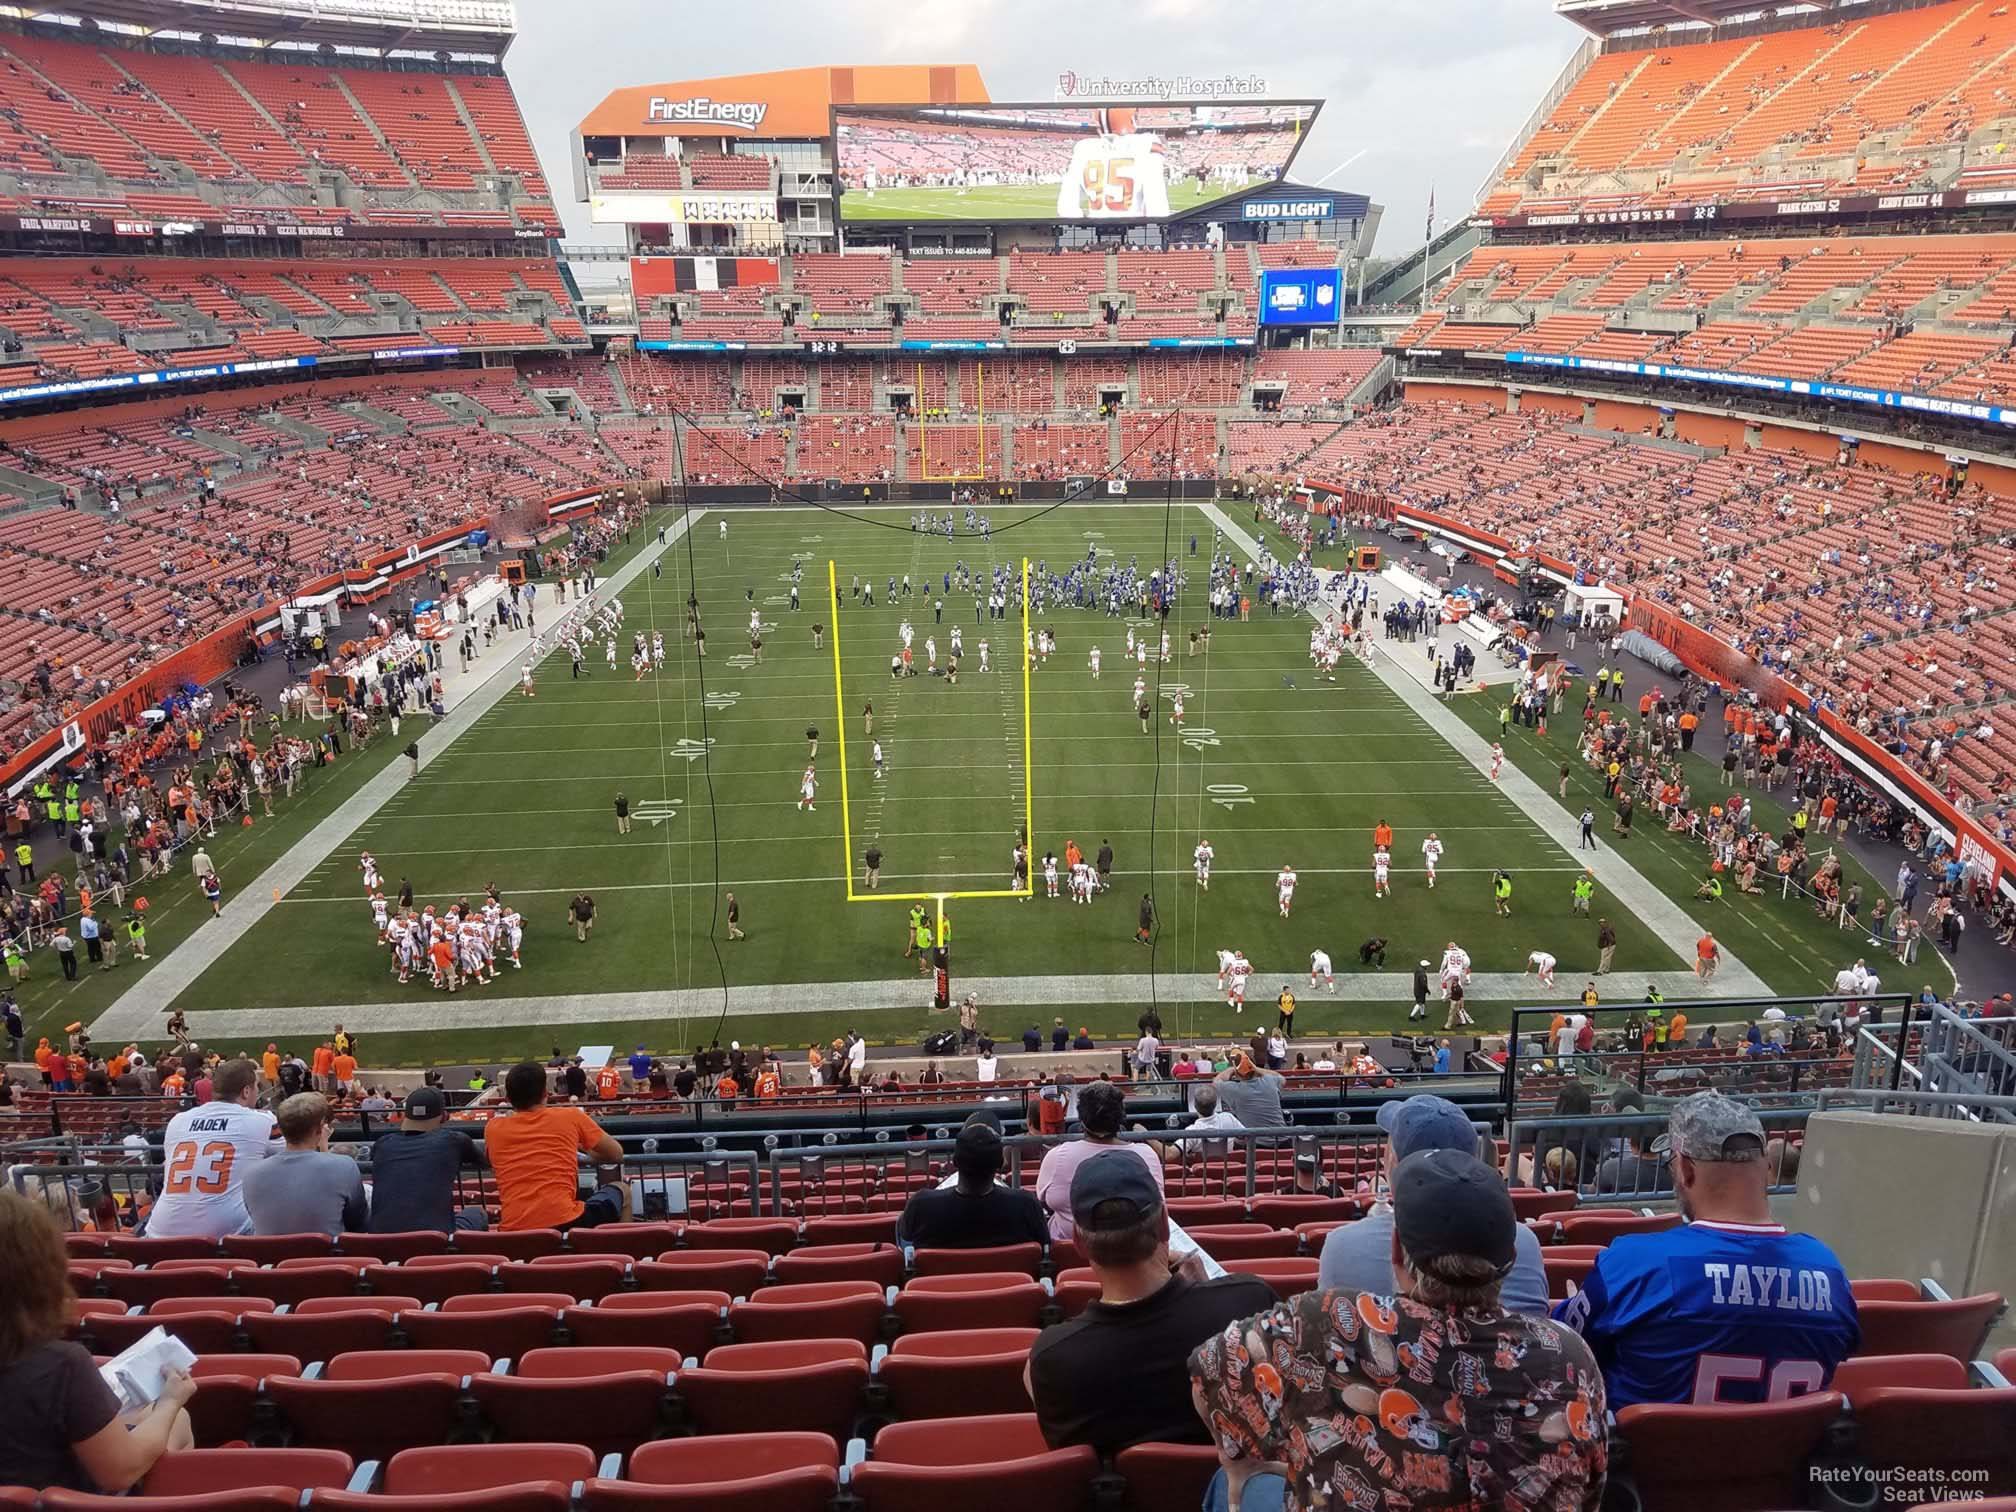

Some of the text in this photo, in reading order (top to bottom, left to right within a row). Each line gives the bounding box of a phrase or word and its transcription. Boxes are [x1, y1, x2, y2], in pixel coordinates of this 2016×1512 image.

[1076, 75, 1265, 99] University Hospitals
[649, 97, 768, 123] FirstEnergy
[1083, 157, 1135, 211] 95
[1878, 193, 1943, 208] LEROY KELLY 44
[1245, 202, 1331, 218] BUD LIGHT
[1694, 206, 1716, 220] 32:12
[20, 218, 41, 230] PAUL
[80, 220, 92, 232] 42
[256, 225, 267, 236] 76
[514, 230, 545, 238] KeyBank
[924, 247, 945, 255] ISSUES
[811, 341, 837, 353] 32:12
[1061, 342, 1074, 351] 25
[1631, 605, 1656, 636] HOME
[1656, 618, 1667, 642] OF
[700, 690, 742, 707] 30
[89, 703, 119, 745] HOME
[122, 692, 135, 722] OF
[1178, 727, 1223, 746] 20
[669, 737, 717, 757] 20
[1206, 783, 1257, 805] 10
[630, 798, 684, 820] 10
[1426, 843, 1439, 853] 95
[1961, 832, 1997, 873] CLEVELAND
[1629, 1027, 1640, 1040] 17
[600, 1076, 612, 1088] 10
[762, 1081, 775, 1094] 23
[188, 1118, 229, 1132] HADEN
[165, 1140, 236, 1195] 23
[1703, 1262, 1833, 1313] TAYLOR
[1336, 1467, 1378, 1504] BROWNS
